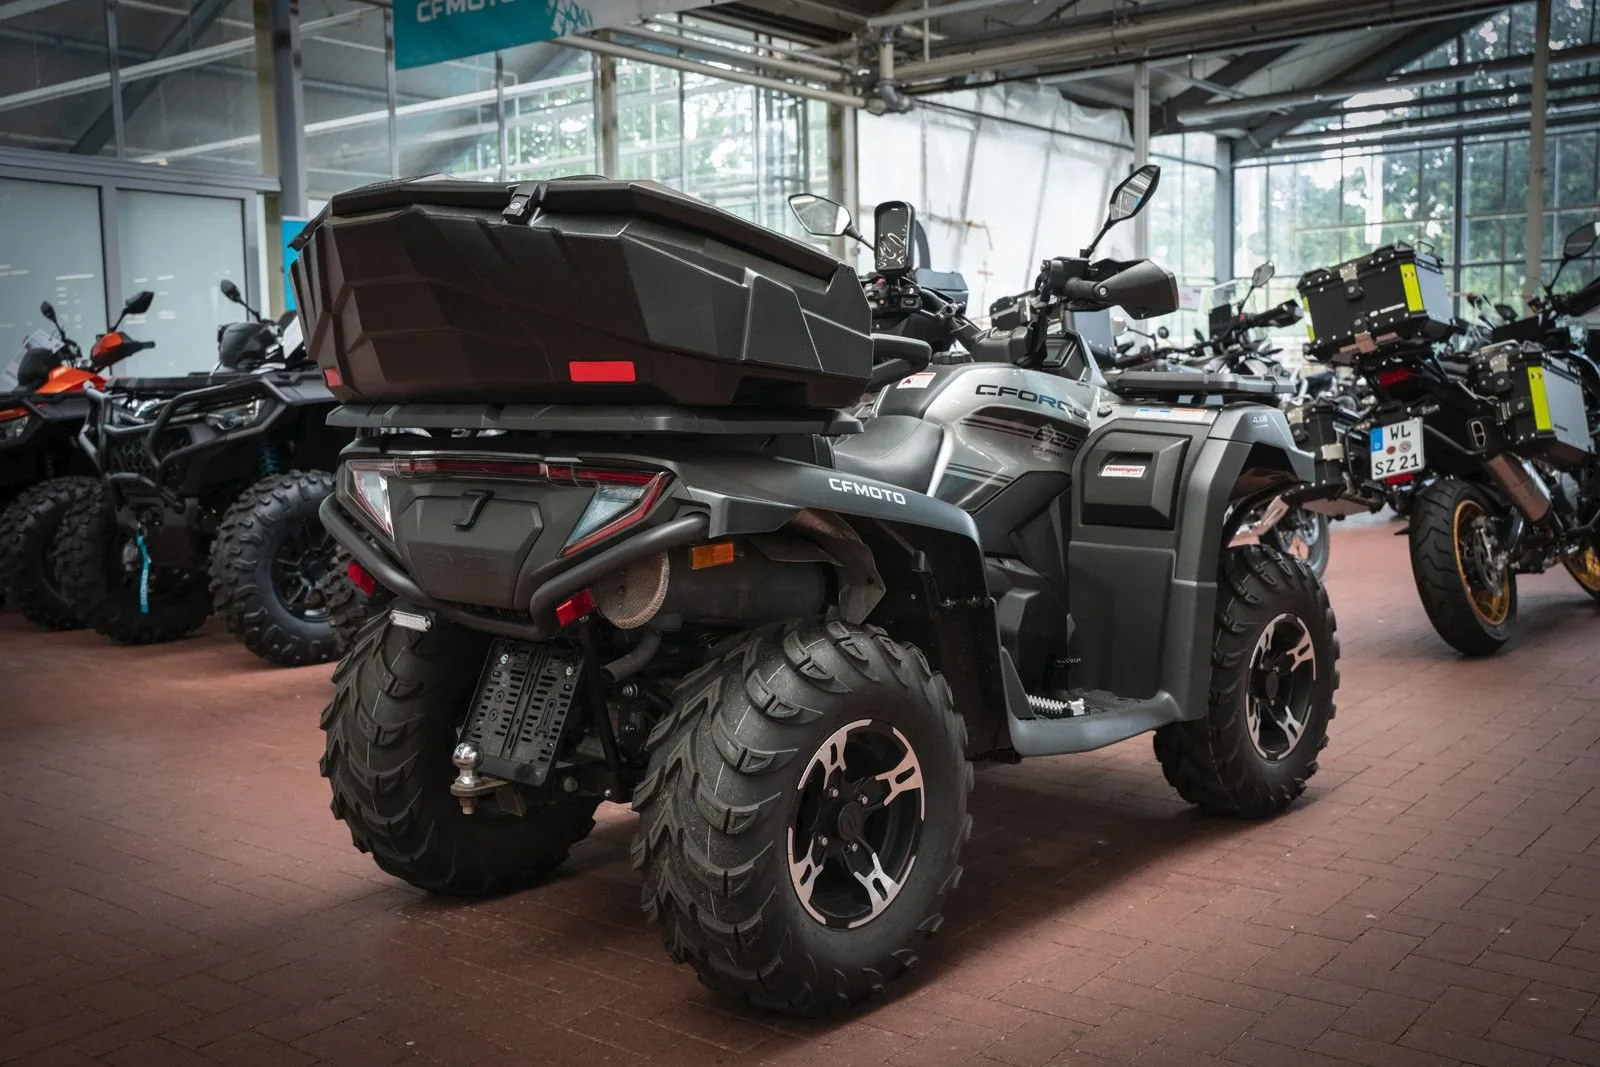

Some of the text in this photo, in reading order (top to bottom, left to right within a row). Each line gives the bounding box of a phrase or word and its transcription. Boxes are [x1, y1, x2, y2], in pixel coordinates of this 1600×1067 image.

[416, 0, 516, 23] CFMO
[975, 384, 1087, 420] CFORCE
[1033, 426, 1081, 451] 625
[1390, 424, 1411, 441] WL
[1375, 453, 1419, 476] SZ 21
[828, 477, 907, 505] CFMOTO
